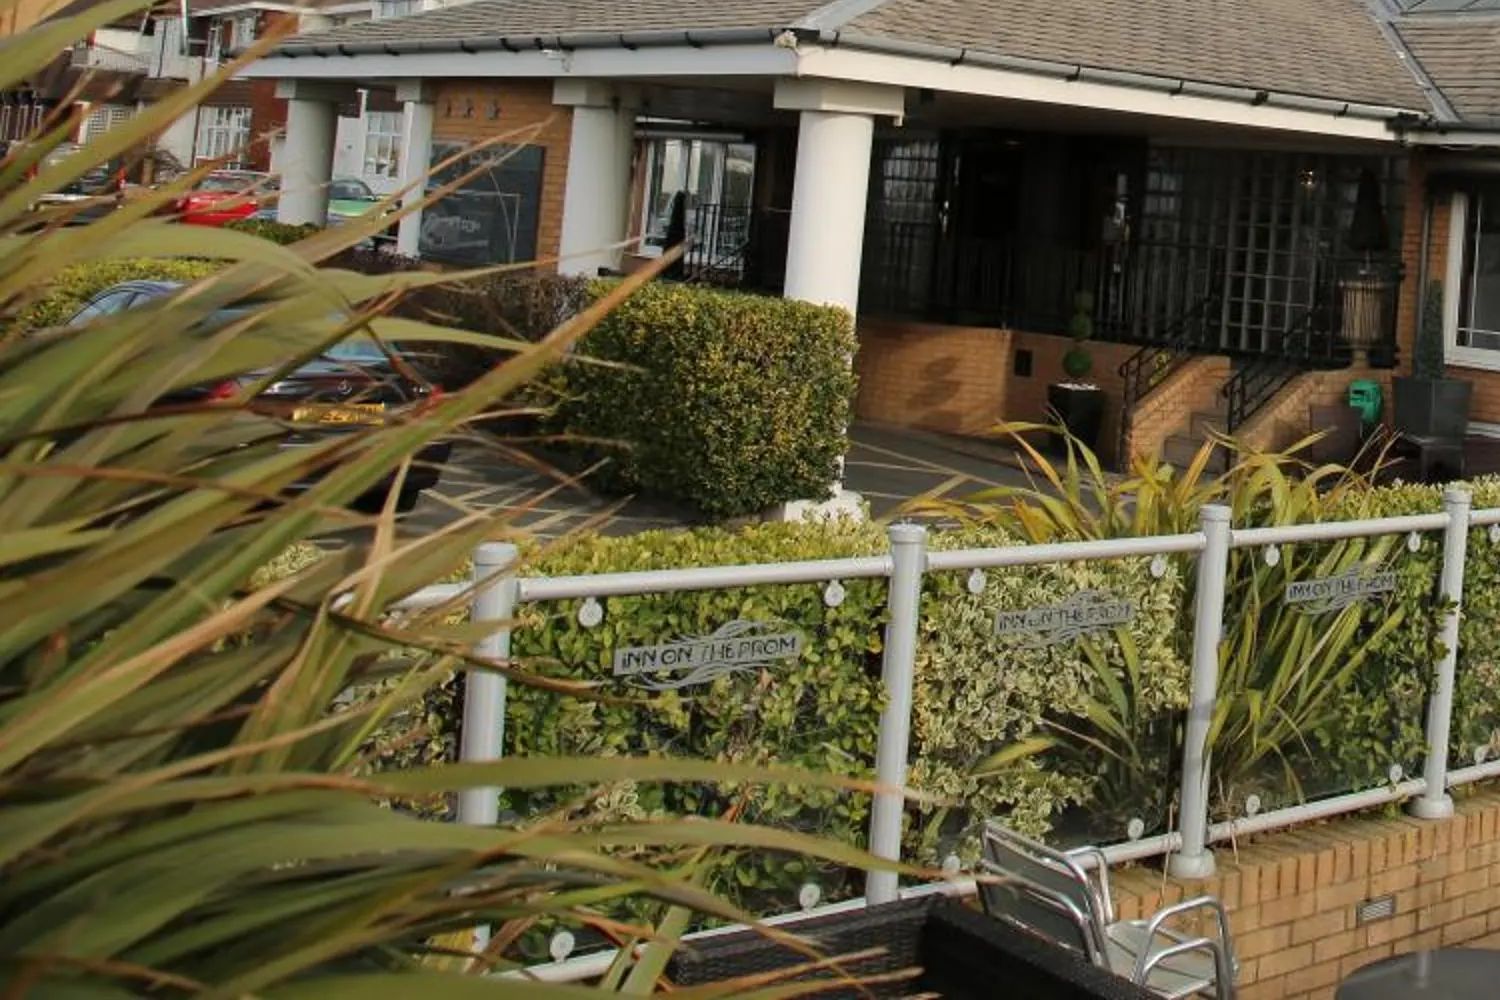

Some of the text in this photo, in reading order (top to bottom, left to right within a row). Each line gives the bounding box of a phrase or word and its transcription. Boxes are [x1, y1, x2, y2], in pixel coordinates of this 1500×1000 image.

[661, 646, 694, 666] ON
[700, 641, 735, 663] THE
[739, 636, 797, 660] PROM
